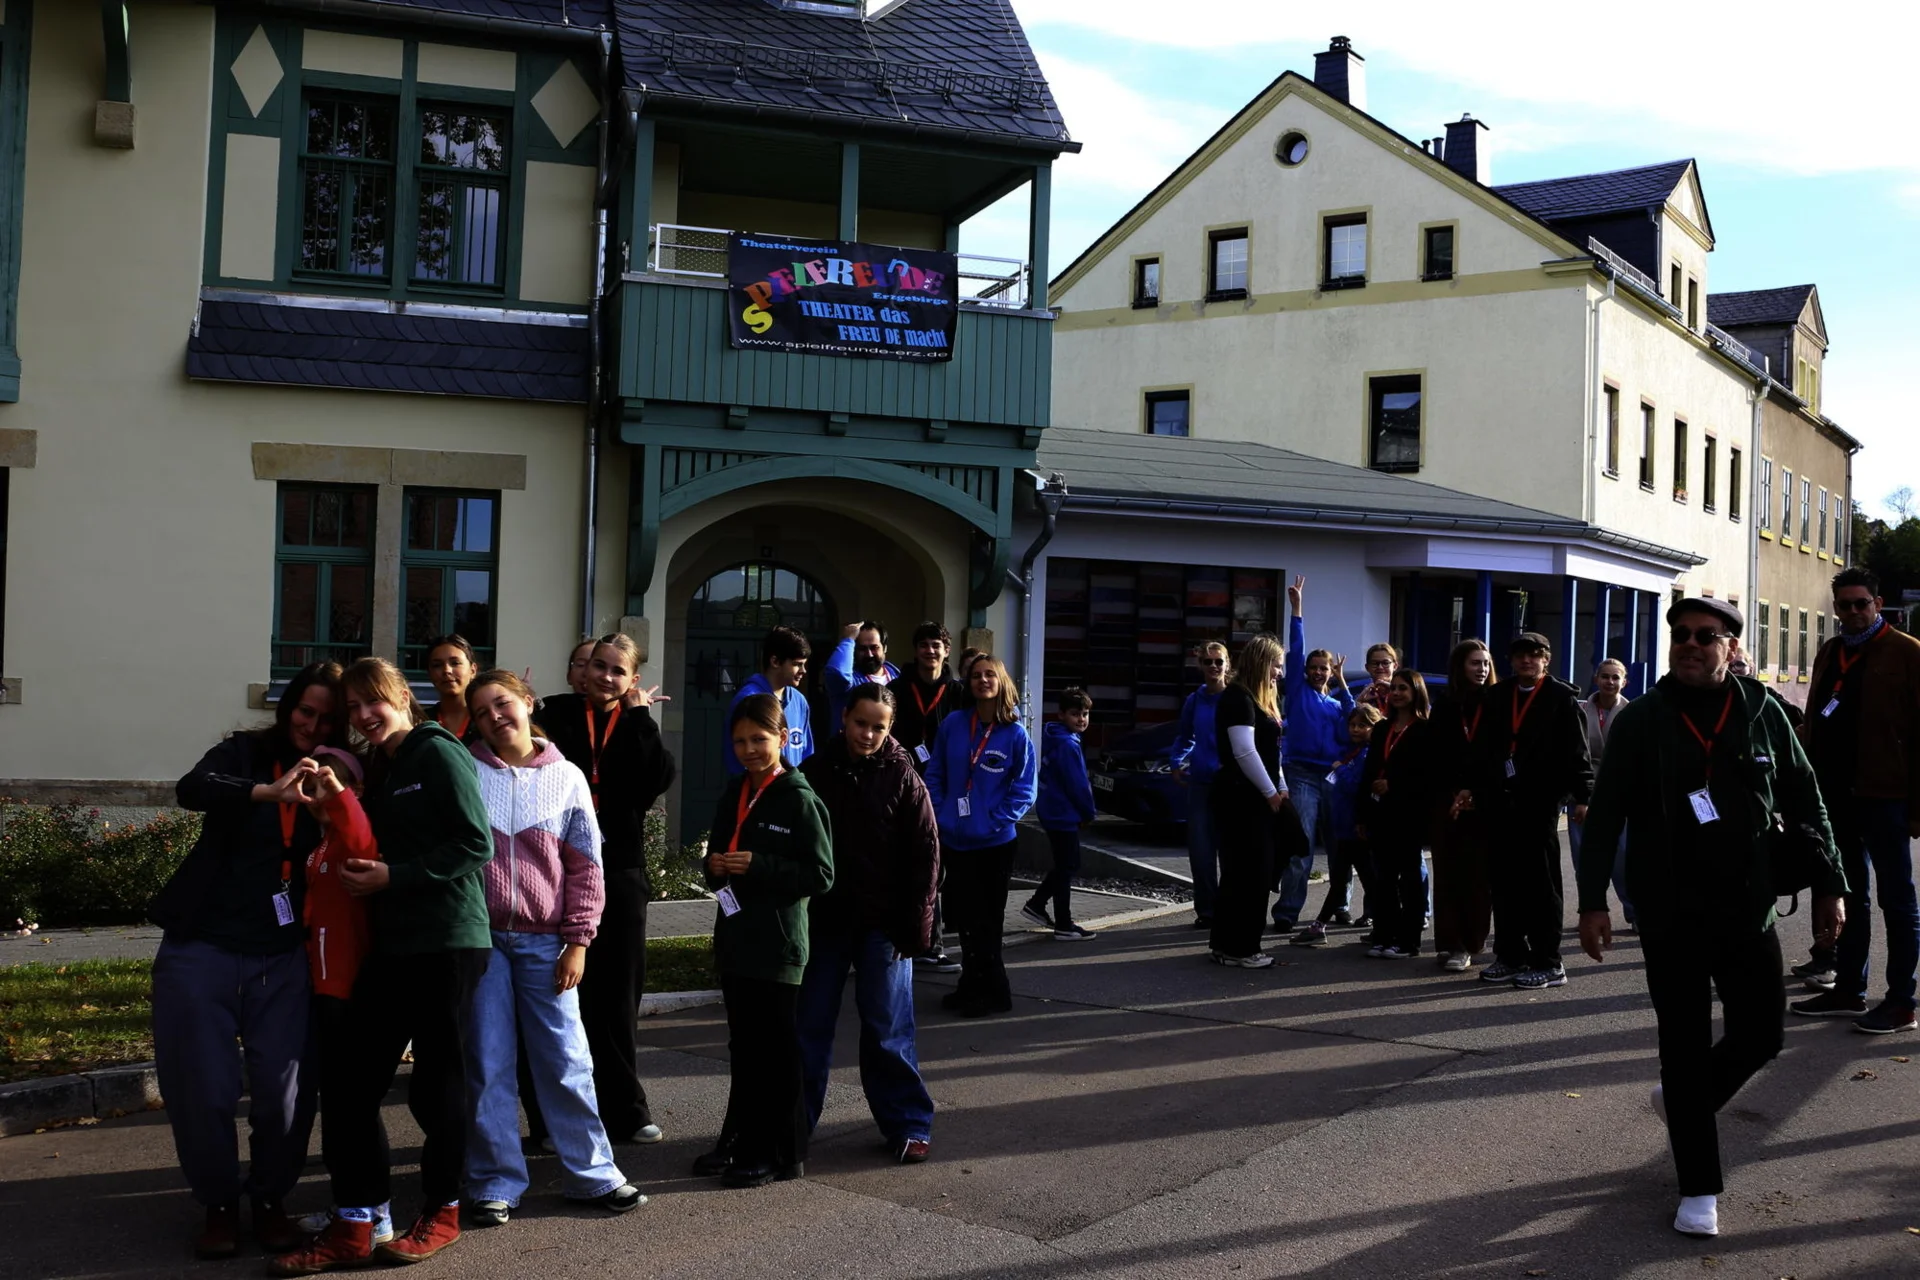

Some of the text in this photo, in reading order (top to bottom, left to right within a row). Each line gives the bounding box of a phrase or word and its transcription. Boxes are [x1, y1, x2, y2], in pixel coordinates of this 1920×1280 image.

[740, 238, 838, 254] Theaterverein
[872, 292, 949, 305] Erzgebirge
[798, 300, 911, 325] THEATER das
[837, 324, 881, 342] FREU
[904, 328, 948, 348] macht
[739, 337, 948, 358] www.spielfreunde-erz.de
